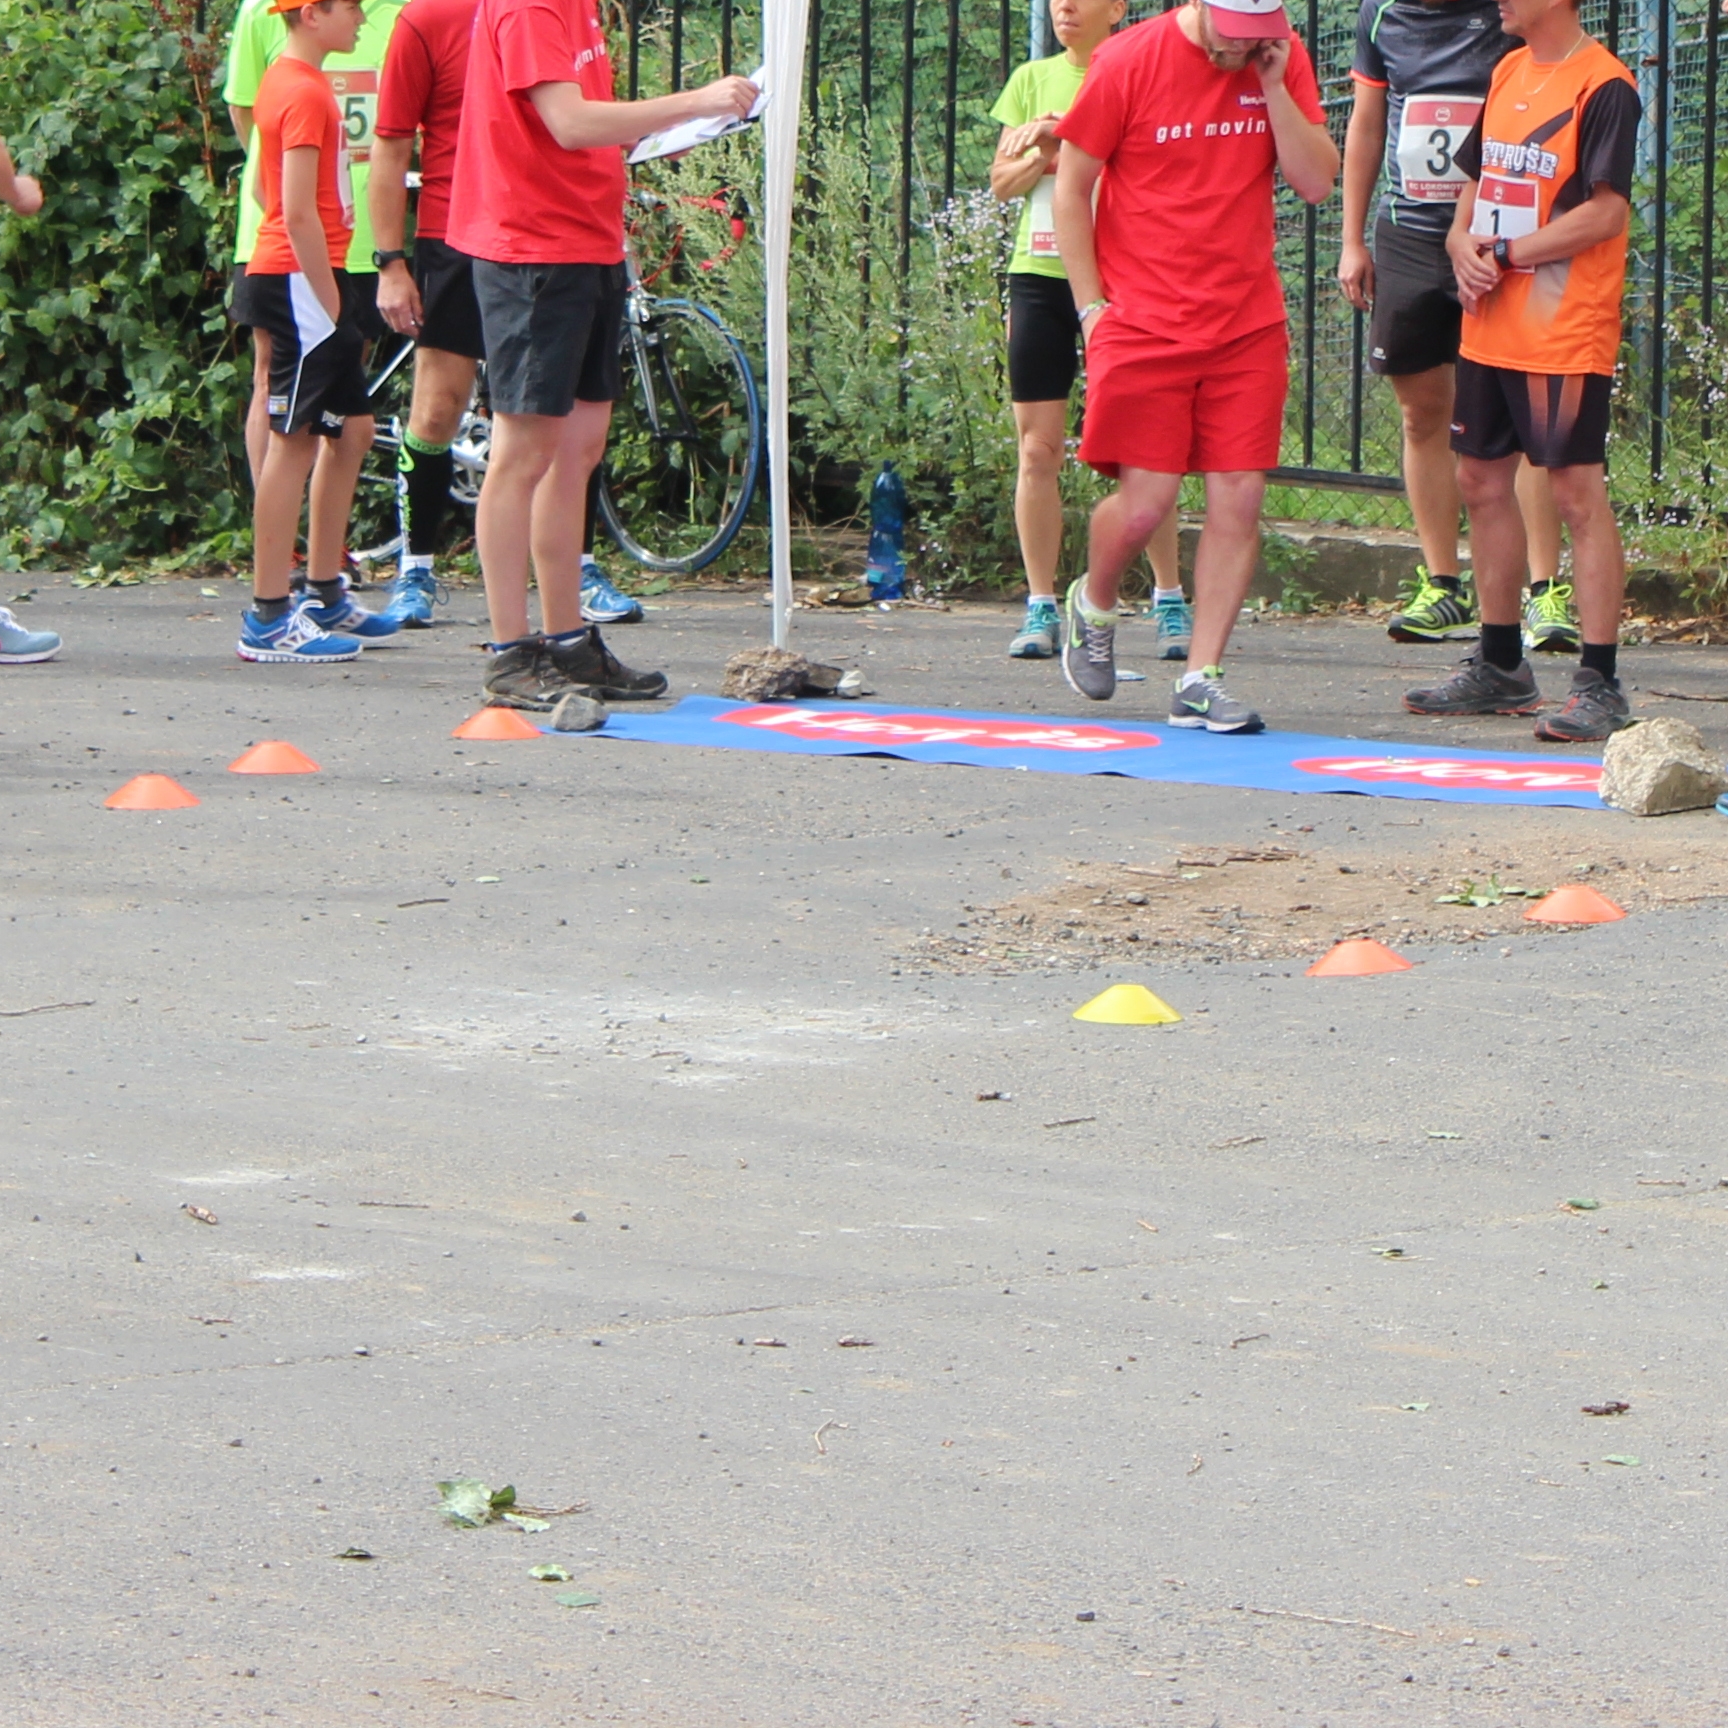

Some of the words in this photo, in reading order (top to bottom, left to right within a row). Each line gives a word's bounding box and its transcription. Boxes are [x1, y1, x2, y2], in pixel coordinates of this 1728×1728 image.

[1156, 123, 1193, 144] get
[1205, 118, 1266, 137] movin
[1427, 129, 1451, 177] 3
[1490, 209, 1500, 235] 1
